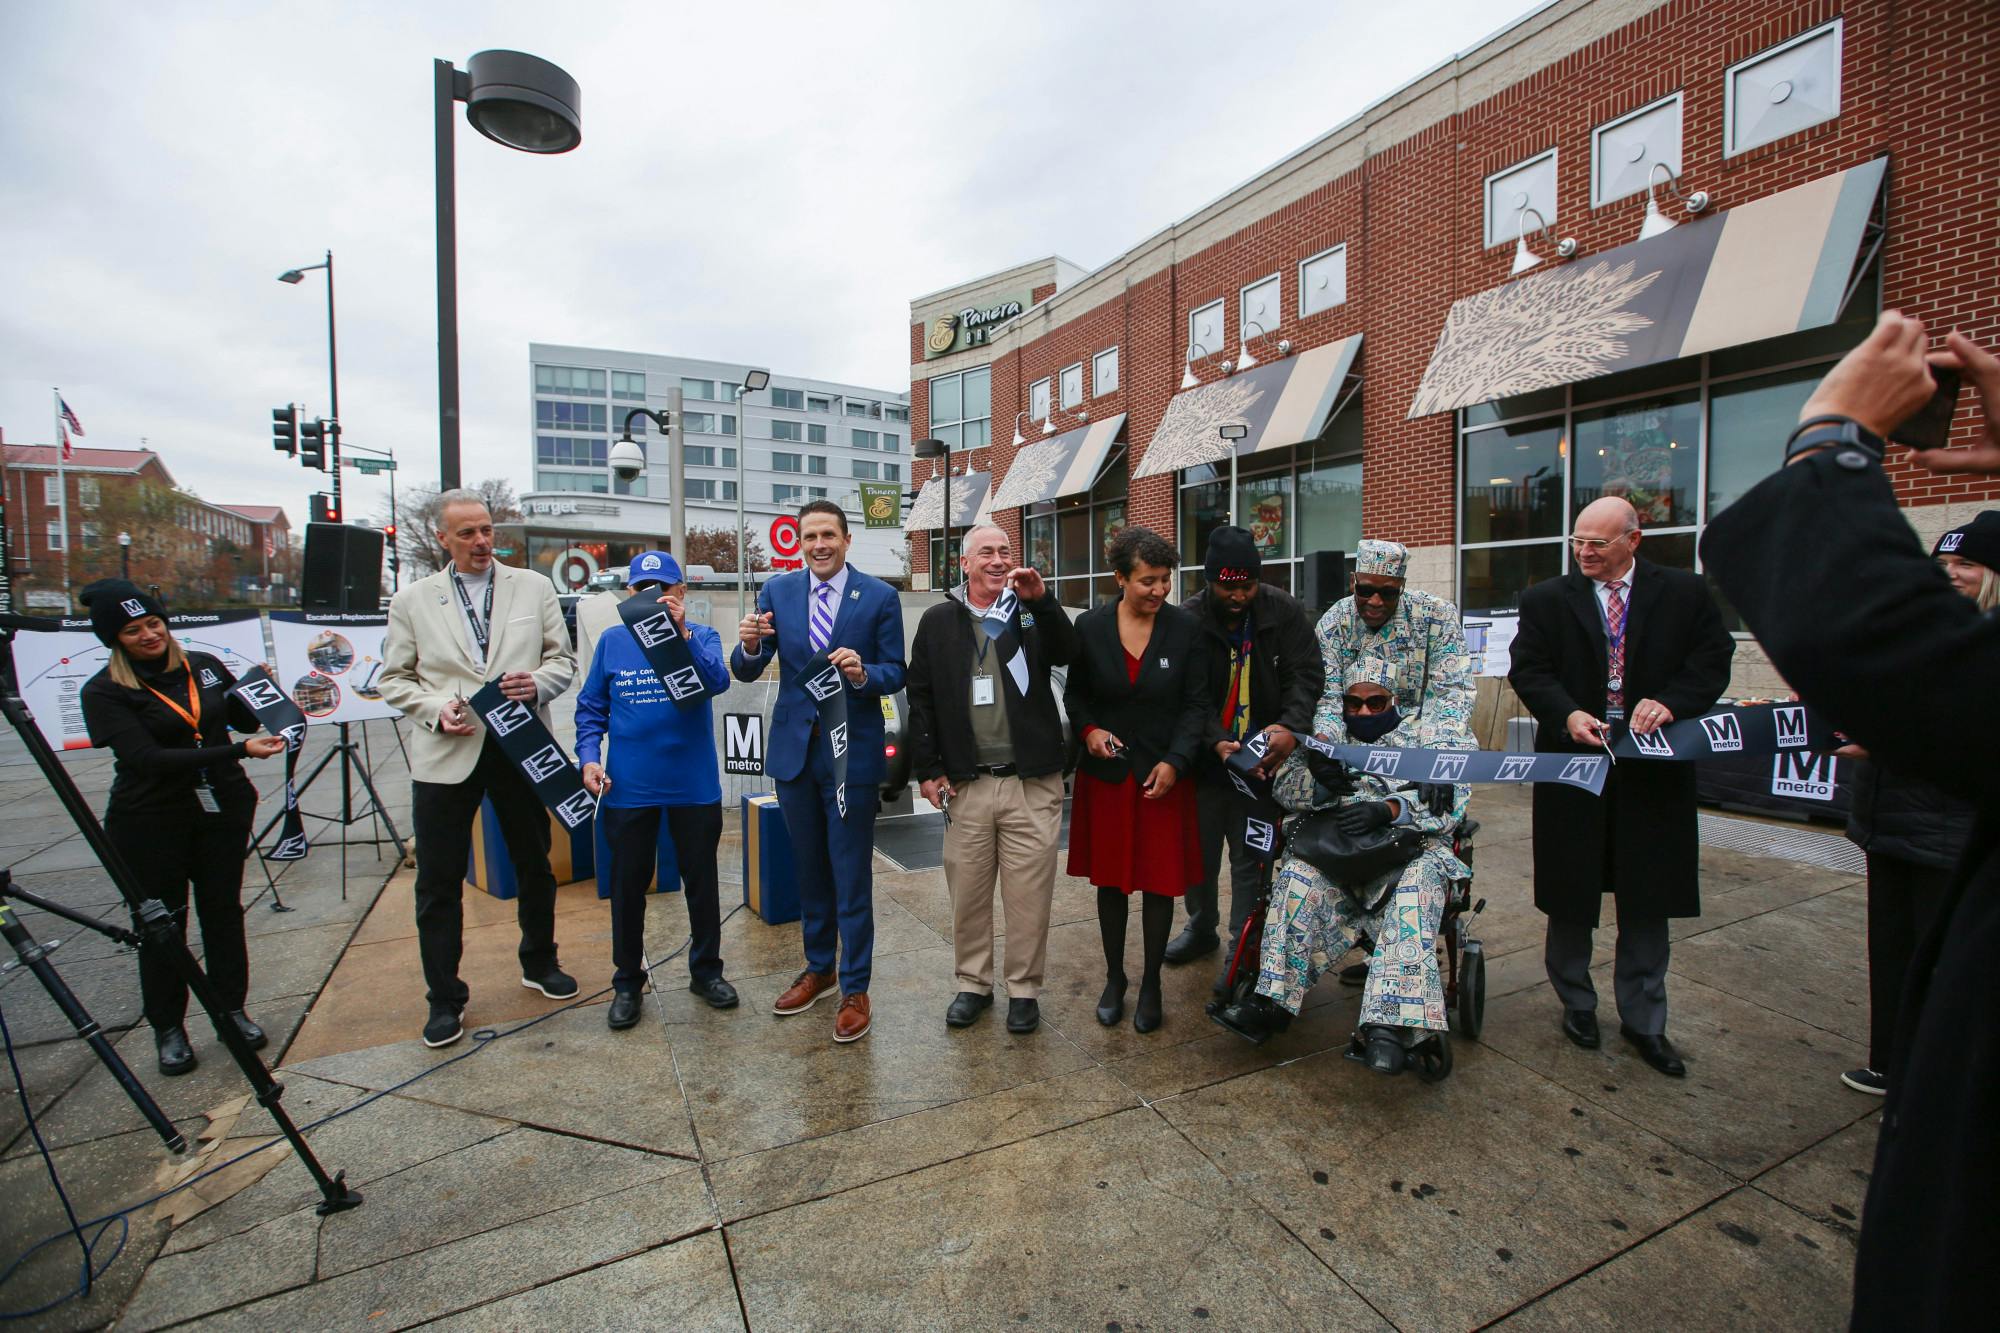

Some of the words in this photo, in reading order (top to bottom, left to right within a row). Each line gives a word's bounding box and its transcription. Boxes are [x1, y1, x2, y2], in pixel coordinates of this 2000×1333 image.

[960, 301, 1019, 328] Panera
[966, 325, 994, 344] BRE
[866, 487, 897, 495] Panera
[532, 500, 578, 516] target
[771, 557, 803, 570] target
[62, 618, 93, 627] Escal
[181, 615, 220, 623] Process
[306, 613, 341, 621] Escalator
[341, 613, 388, 621] Replacement
[636, 624, 653, 646] metro
[642, 614, 675, 643] M
[636, 676, 660, 685] bette
[666, 676, 682, 698] metro
[672, 669, 702, 696] M
[808, 681, 824, 698] metro
[815, 667, 840, 695] M
[241, 687, 261, 708] metro
[247, 681, 282, 705] M
[489, 712, 507, 734] metro
[495, 700, 530, 730] M
[1776, 708, 1805, 736] M
[726, 716, 760, 759] M
[1703, 715, 1740, 741] M
[1634, 730, 1667, 749] M
[1713, 740, 1740, 749] metro
[1779, 736, 1805, 744] metro
[525, 760, 542, 780] metro
[530, 746, 564, 777] M
[727, 760, 761, 771] metro
[1778, 752, 1831, 783] M
[1777, 781, 1828, 795] metro
[559, 805, 577, 825] metro
[565, 791, 597, 821] M
[1247, 820, 1267, 847] M
[1264, 825, 1272, 849] metro
